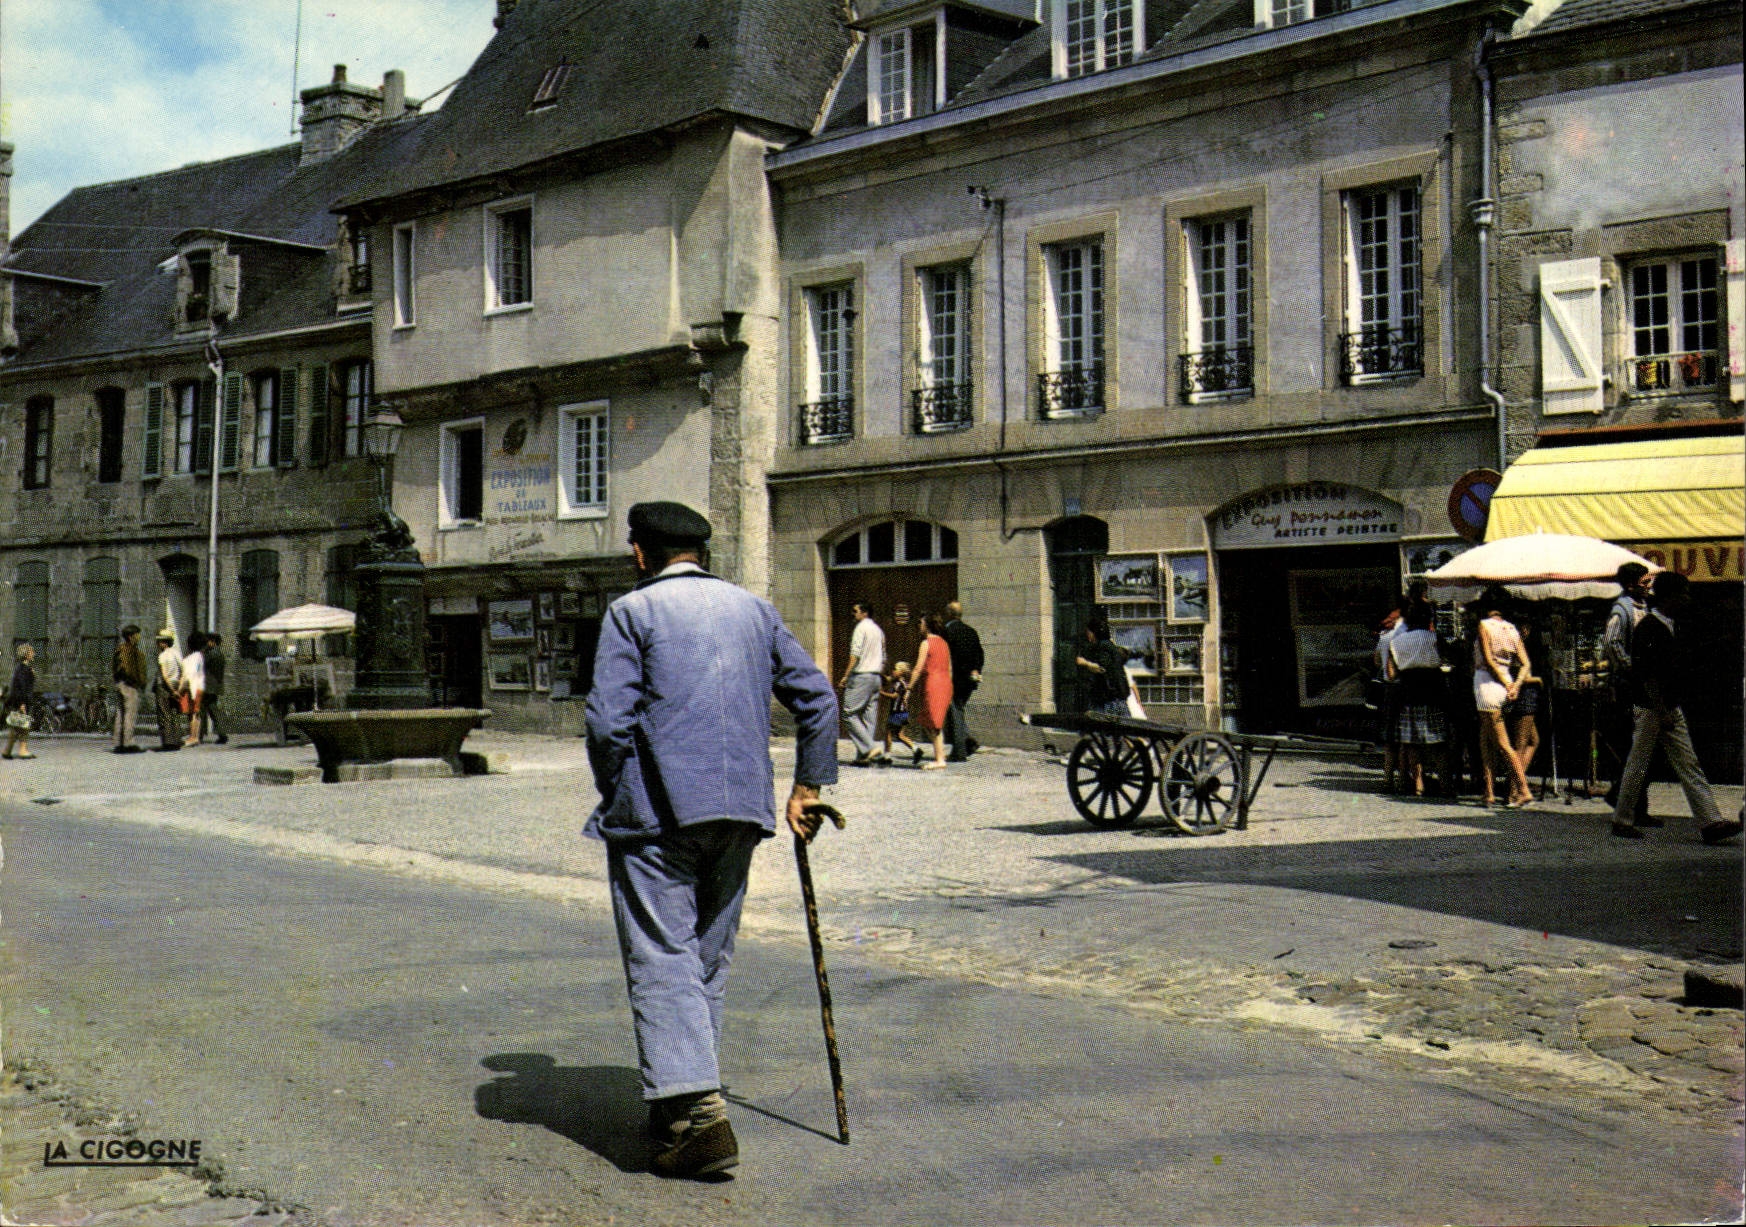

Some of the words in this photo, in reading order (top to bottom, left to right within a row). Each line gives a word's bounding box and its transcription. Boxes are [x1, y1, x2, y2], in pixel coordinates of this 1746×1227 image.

[1274, 527, 1327, 538] ARTISTE
[1337, 523, 1398, 535] PEINTRE
[1641, 546, 1744, 578] OUV
